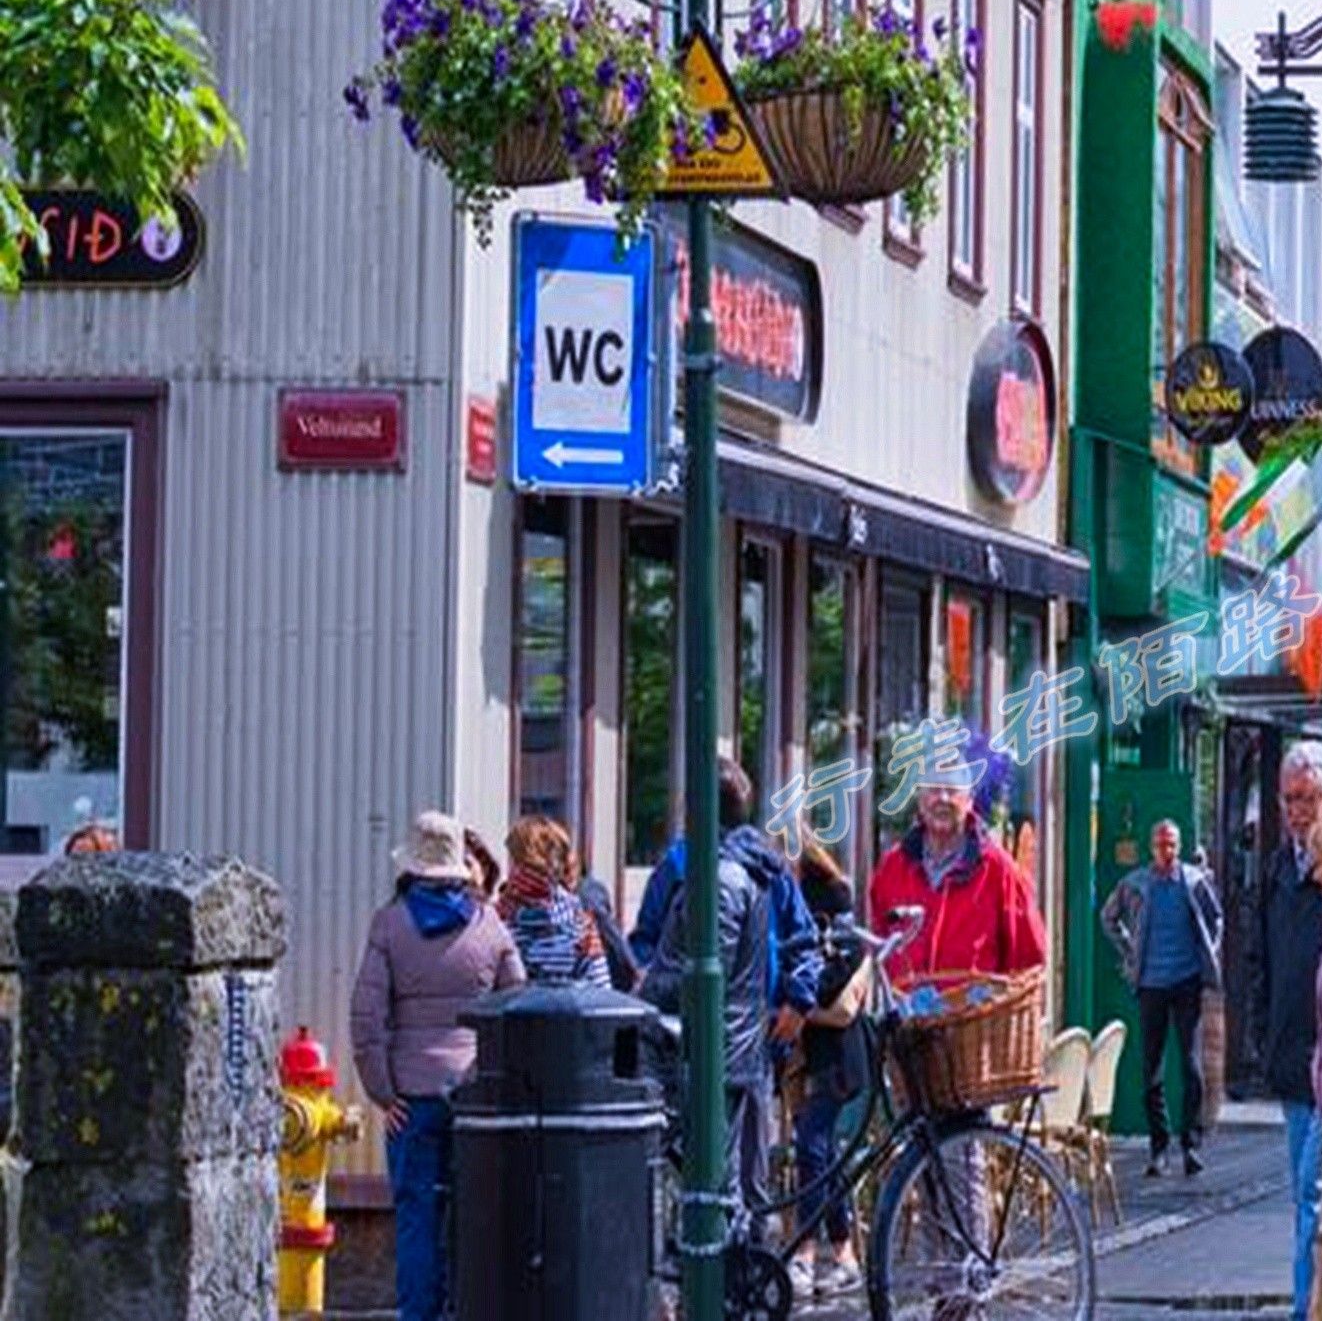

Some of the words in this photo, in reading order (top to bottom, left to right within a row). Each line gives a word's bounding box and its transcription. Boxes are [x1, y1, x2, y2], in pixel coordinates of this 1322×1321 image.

[545, 326, 625, 385] WC
[1175, 387, 1243, 413] VIKING
[1250, 398, 1320, 421] UINNESS
